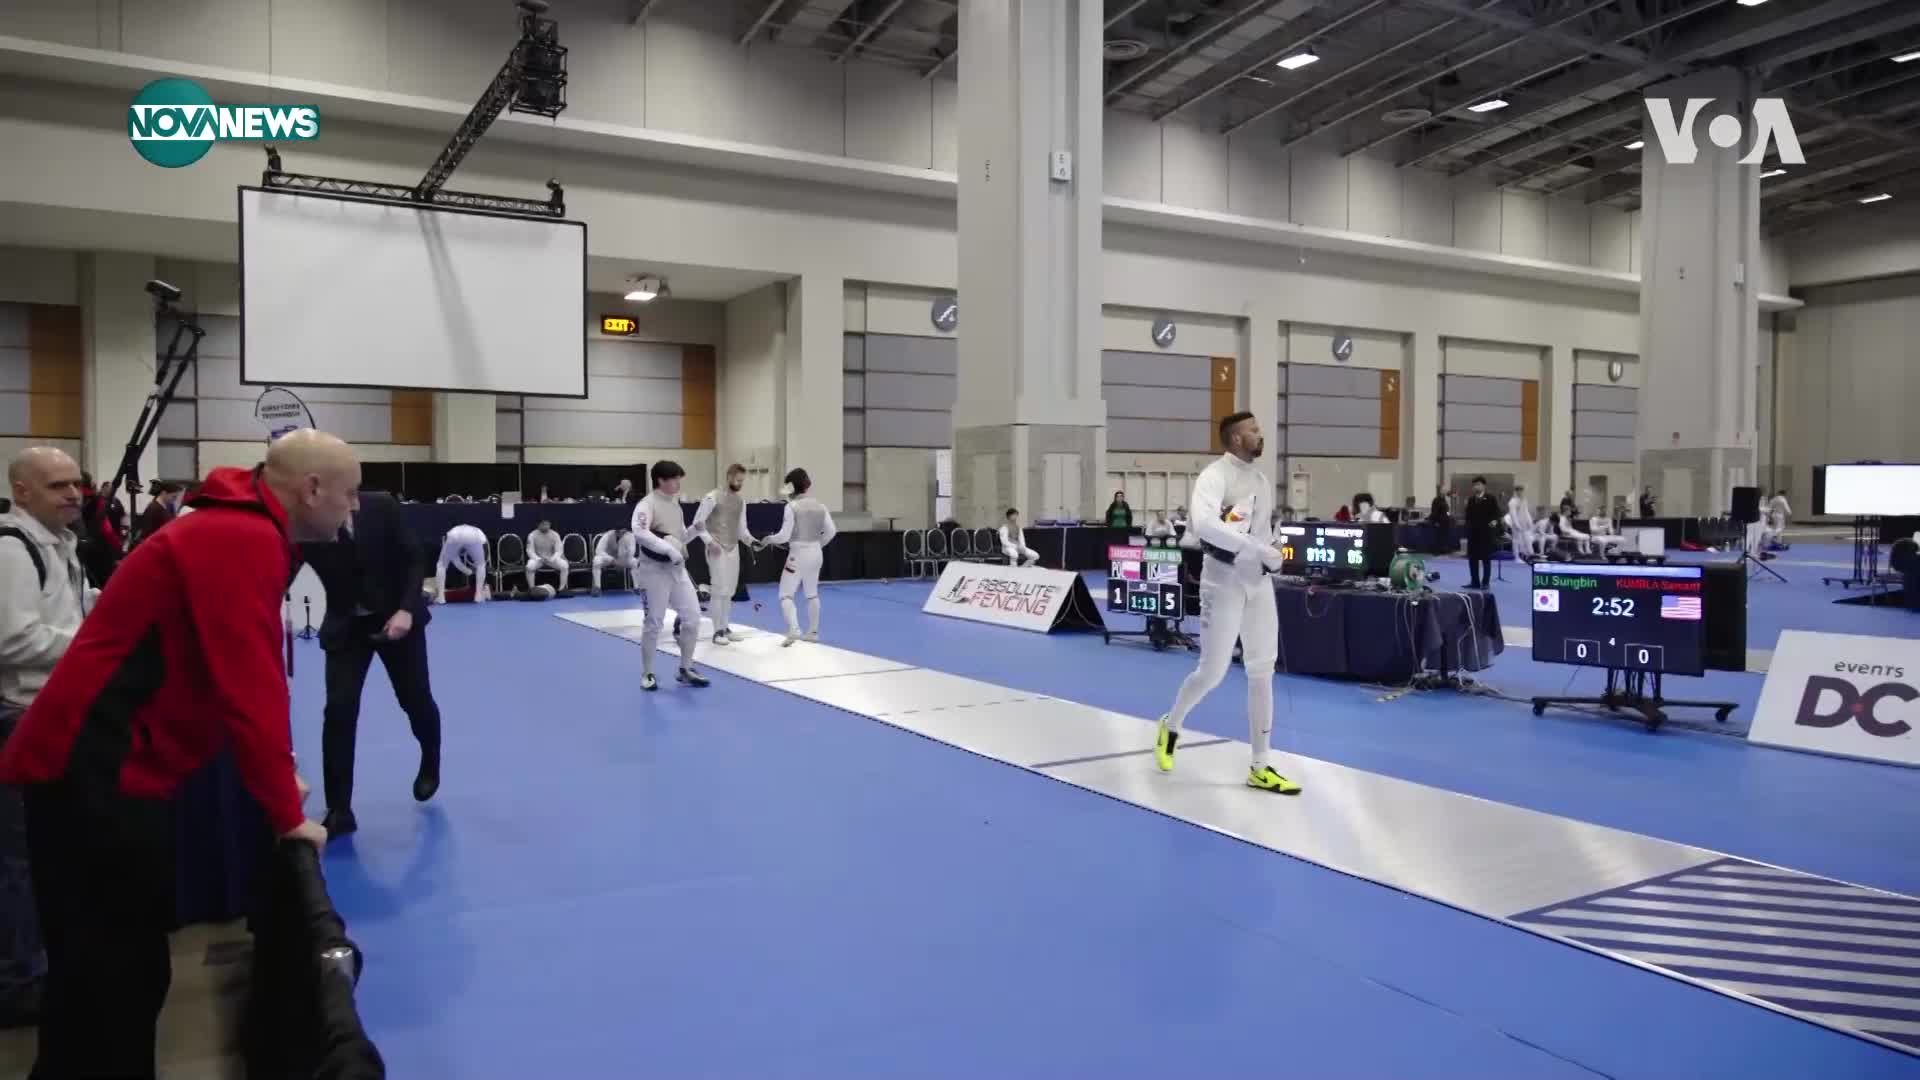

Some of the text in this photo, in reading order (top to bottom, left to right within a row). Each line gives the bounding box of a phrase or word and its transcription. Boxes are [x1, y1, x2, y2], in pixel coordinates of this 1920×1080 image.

[977, 578, 1057, 599] ABSOLUTE
[1114, 587, 1122, 604] 1
[968, 591, 1049, 616] FENCING
[1131, 595, 1157, 611] 1:13
[1165, 592, 1176, 610] 5
[1591, 596, 1635, 617] 2:52
[1576, 643, 1588, 659] 0
[1638, 649, 1650, 665] 0
[1834, 661, 1905, 678] events
